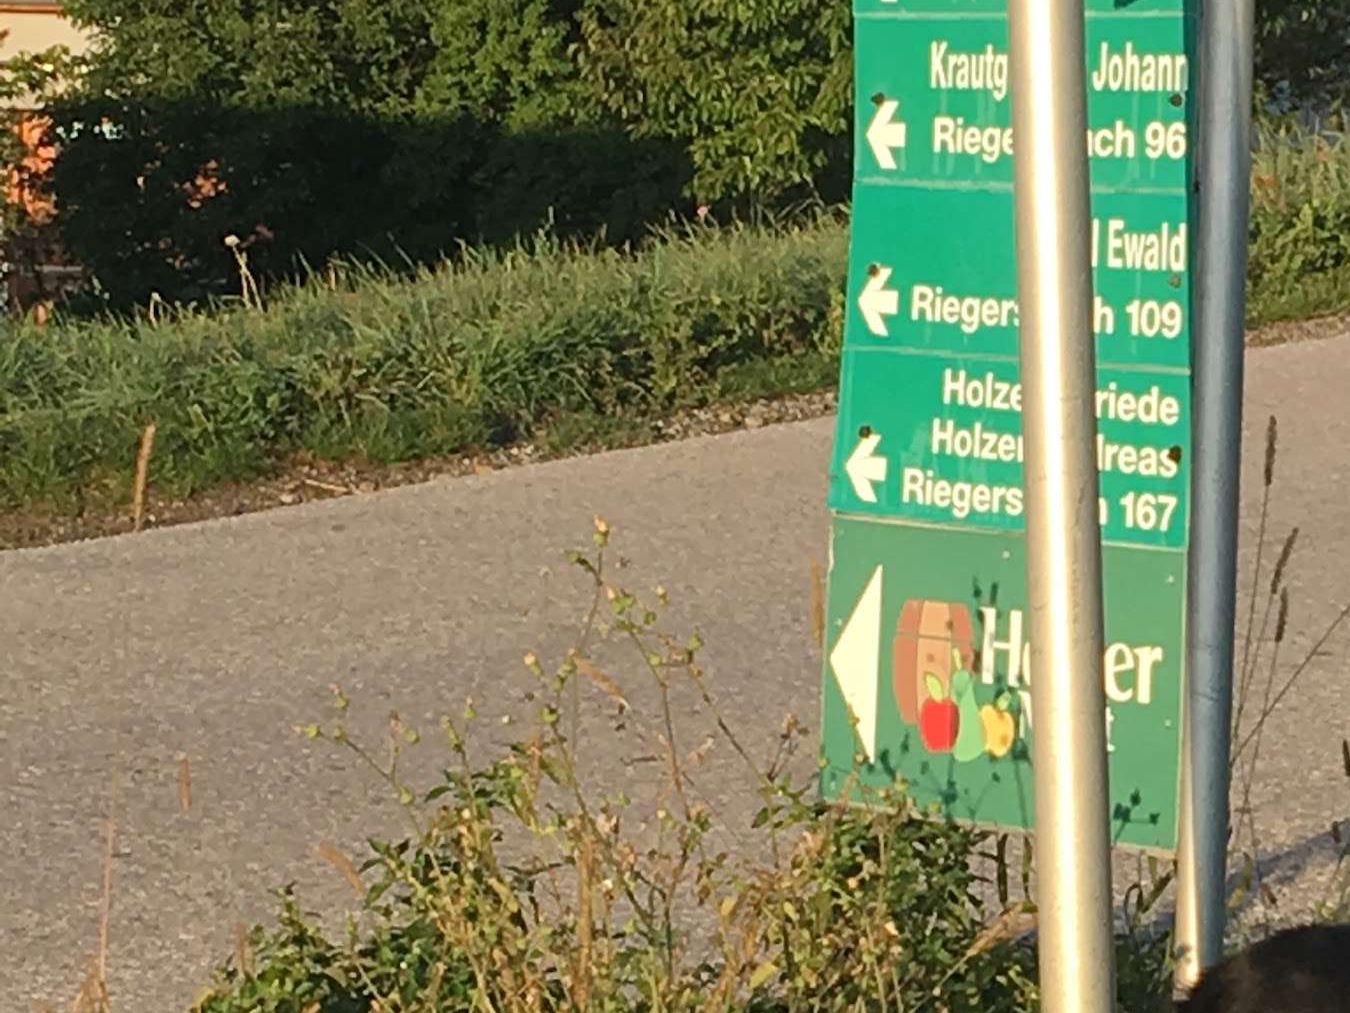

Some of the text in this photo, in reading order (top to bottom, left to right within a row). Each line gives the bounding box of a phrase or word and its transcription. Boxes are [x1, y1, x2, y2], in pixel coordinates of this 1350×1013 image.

[1092, 41, 1189, 92] Johann
[1145, 121, 1187, 159] 96
[1107, 219, 1187, 272] Ewald
[1126, 299, 1182, 339] 109
[943, 368, 1023, 412] Holze
[1120, 491, 1178, 532] 167
